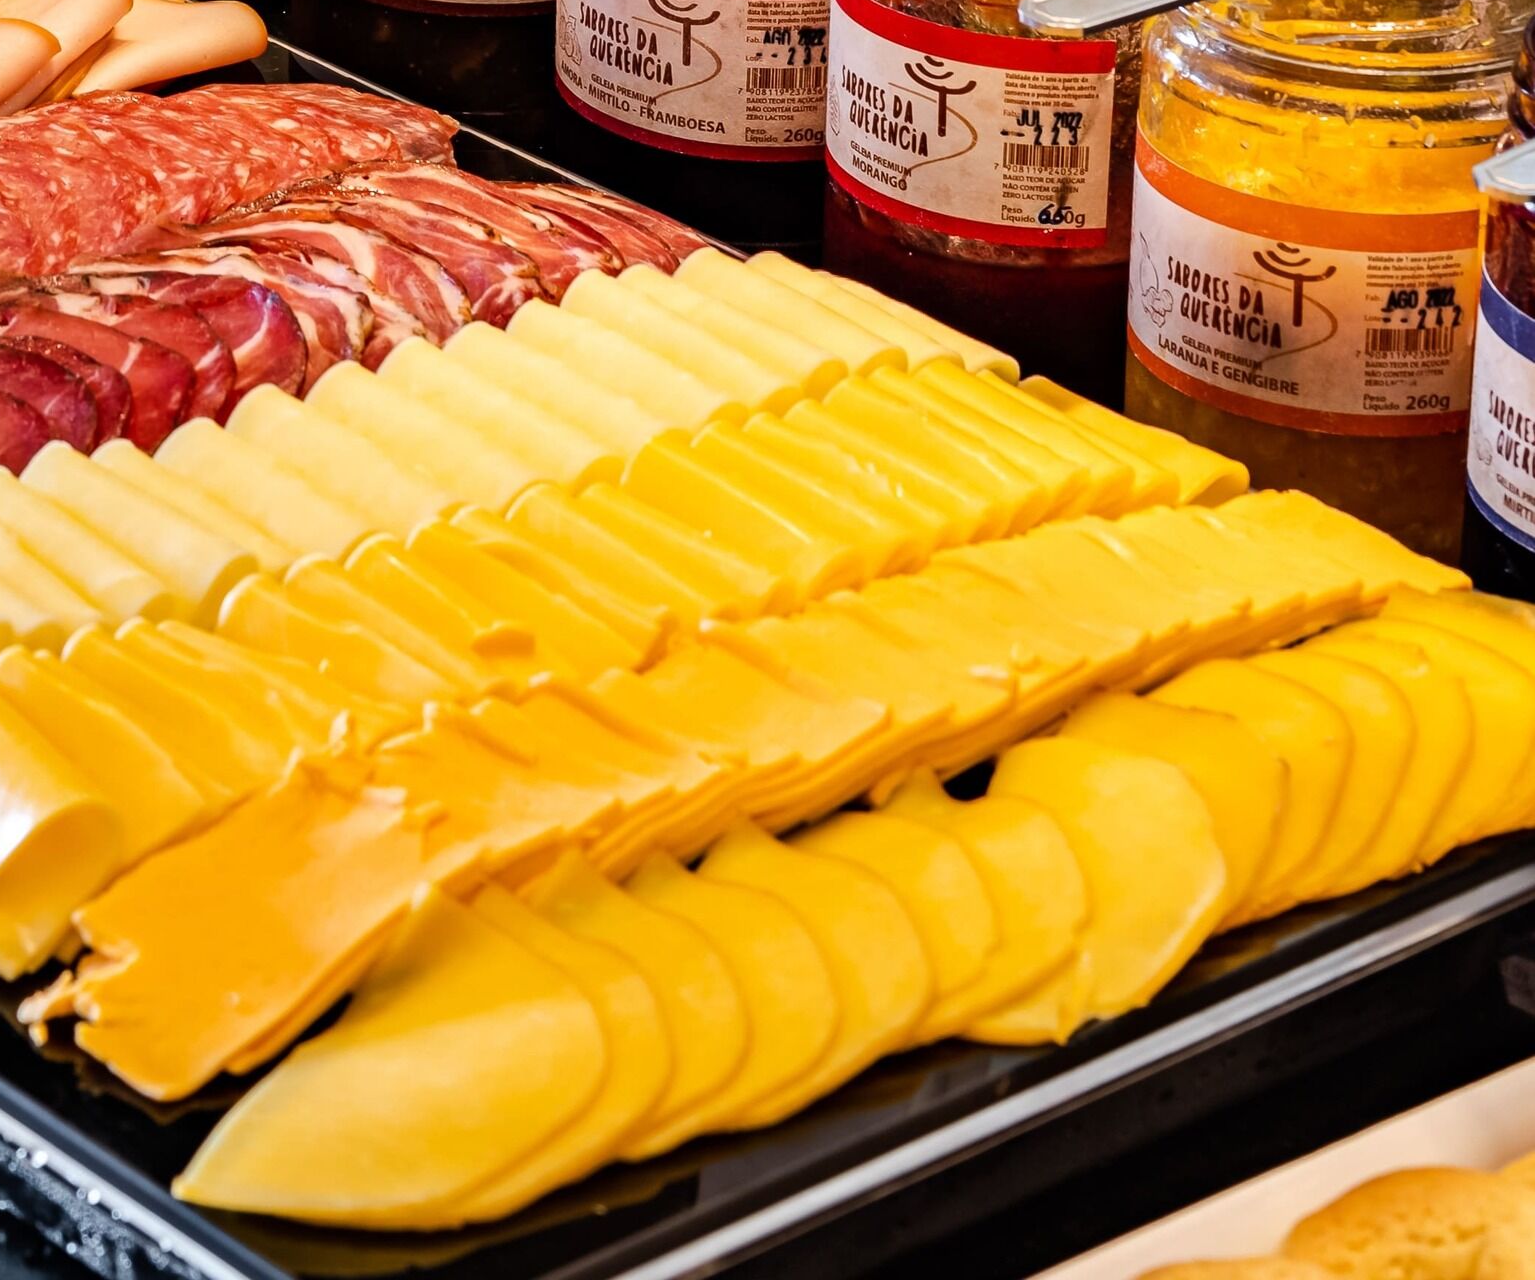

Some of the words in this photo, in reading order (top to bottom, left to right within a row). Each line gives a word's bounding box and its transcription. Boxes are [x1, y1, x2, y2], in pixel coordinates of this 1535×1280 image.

[580, 1, 629, 45] SABORES
[636, 28, 658, 56] DA
[561, 60, 583, 90] AMORA
[588, 84, 631, 112] MIRTILO
[639, 105, 726, 134] FRAMBOESA
[591, 73, 615, 92] GELEIA
[616, 85, 657, 107] PREMIUM
[842, 65, 885, 112] SABORES
[893, 95, 913, 124] DA
[745, 127, 767, 135] Peso
[745, 135, 778, 144] Líquido
[783, 129, 825, 145] 260g
[850, 140, 872, 161] GELEIA
[873, 154, 912, 177] PREMIUM
[994, 162, 999, 170] 7
[852, 154, 907, 191] MORANGO
[1002, 173, 1024, 181] BAIXO
[1026, 175, 1044, 183] TEOR
[1045, 176, 1054, 184] DE
[1002, 182, 1019, 190] NÃO
[1022, 192, 1055, 201] LACTOSE
[1001, 203, 1023, 214] Peso
[1001, 212, 1036, 224] Líquido
[1168, 256, 1229, 304] SABORES
[1239, 285, 1263, 316] DA
[1383, 289, 1419, 311] AGO
[1182, 335, 1211, 354] GELEIA
[1214, 348, 1263, 371] PREMIUM
[1158, 333, 1208, 371] LARANJA
[1211, 361, 1219, 374] E
[1222, 365, 1300, 396] GENGIBRE
[1363, 393, 1386, 402] Peso
[1363, 401, 1400, 411] Líquido
[1406, 393, 1451, 411] 260g
